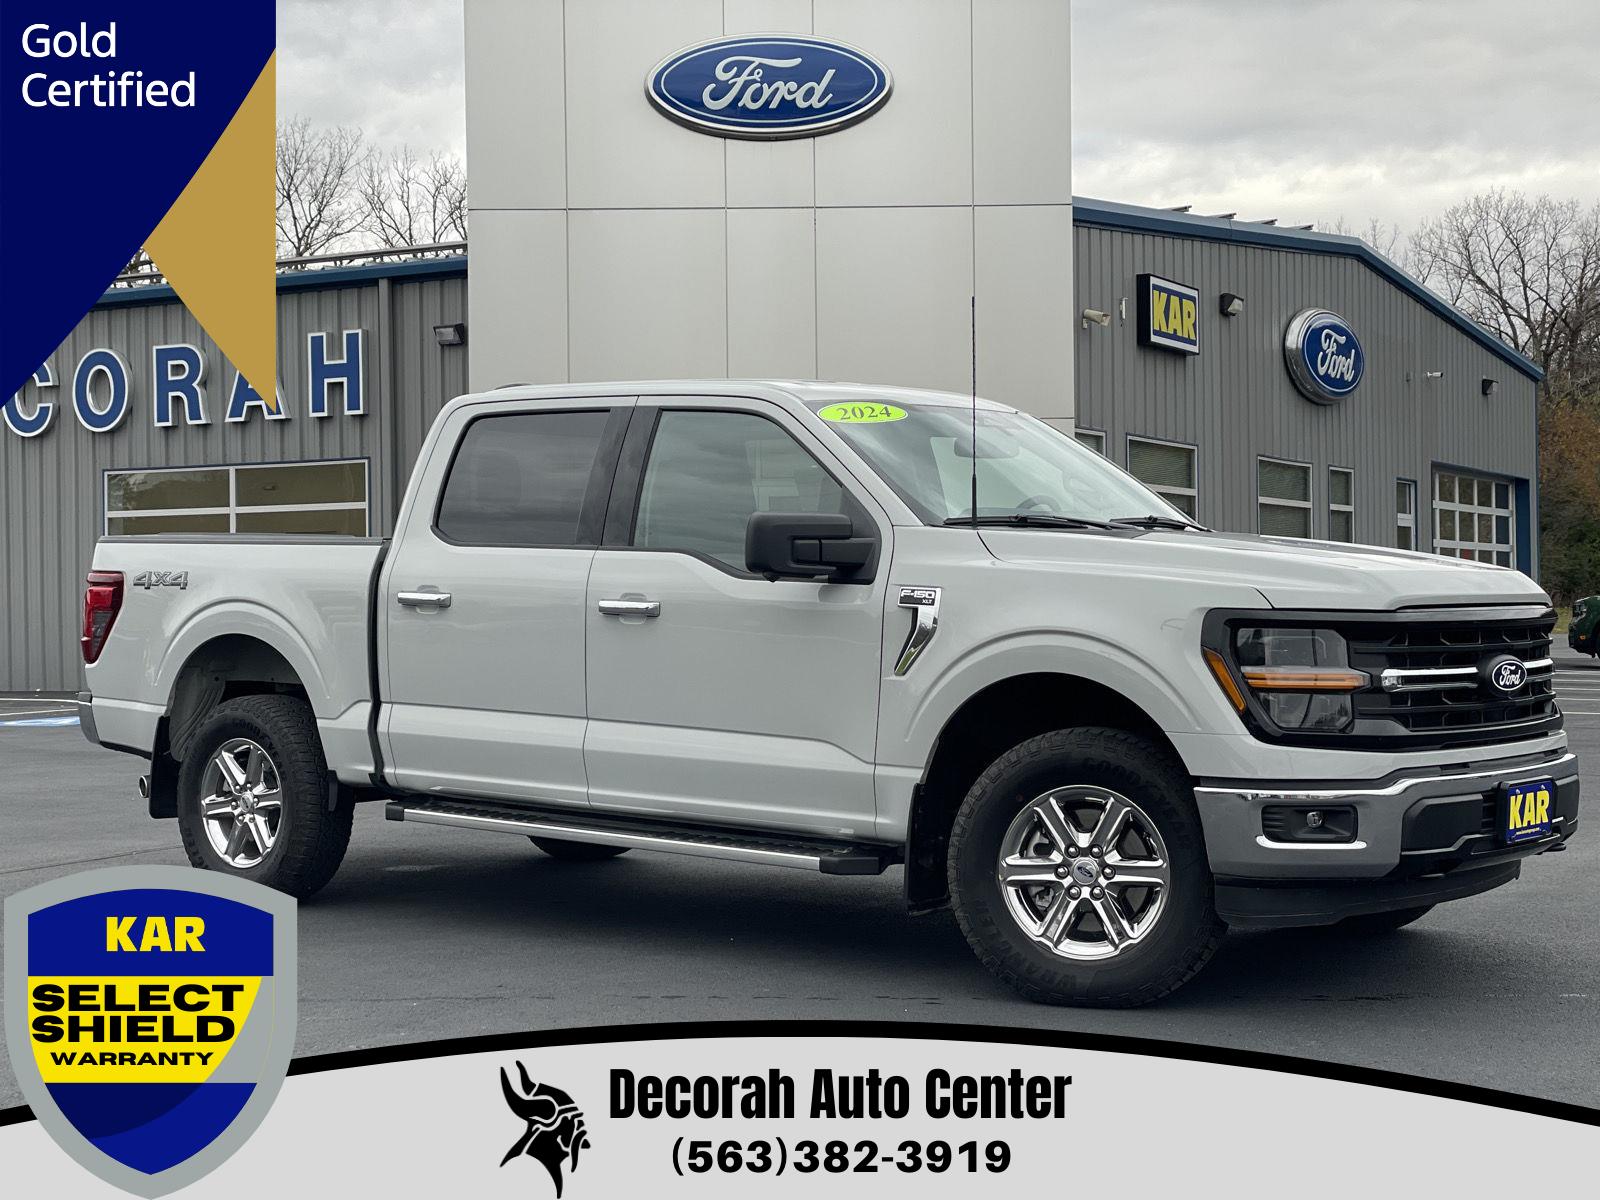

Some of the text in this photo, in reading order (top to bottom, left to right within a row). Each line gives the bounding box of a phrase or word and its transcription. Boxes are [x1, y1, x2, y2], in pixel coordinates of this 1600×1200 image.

[702, 55, 836, 110] Ford
[1153, 290, 1196, 340] KAR
[1317, 328, 1355, 382] Ford
[836, 405, 892, 420] 2024
[900, 590, 935, 599] F-150
[1499, 664, 1521, 686] Ford
[1509, 789, 1550, 830] KAR
